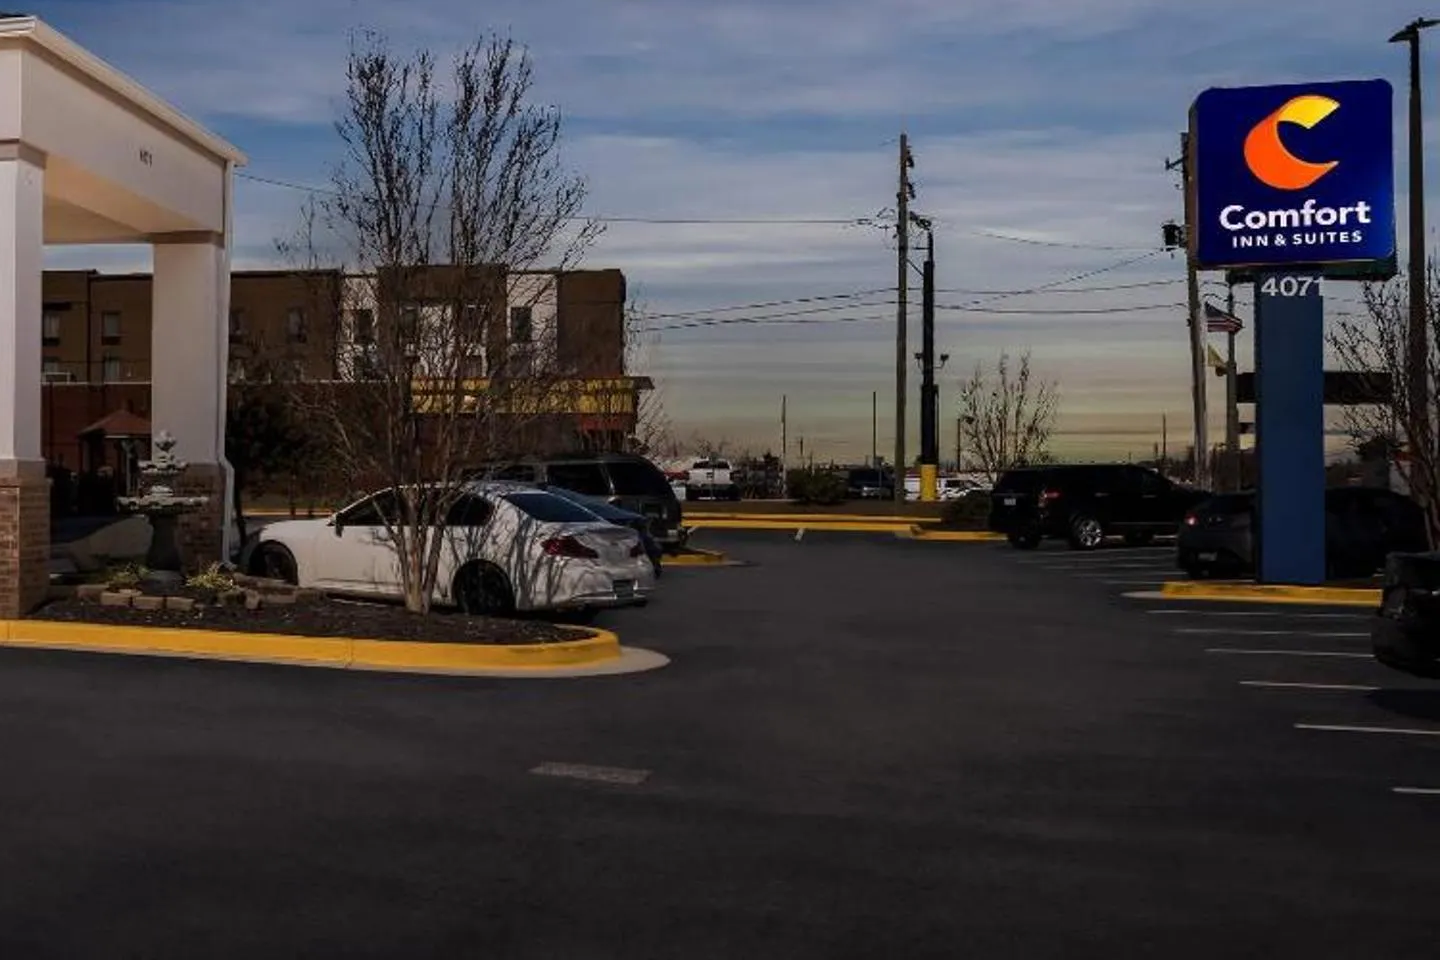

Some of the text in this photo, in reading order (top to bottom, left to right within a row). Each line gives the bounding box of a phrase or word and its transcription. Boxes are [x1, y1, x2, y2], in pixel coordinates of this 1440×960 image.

[1219, 199, 1371, 231] Comfort
[1232, 230, 1362, 248] INN & SUITES
[1260, 275, 1324, 297] 4071
